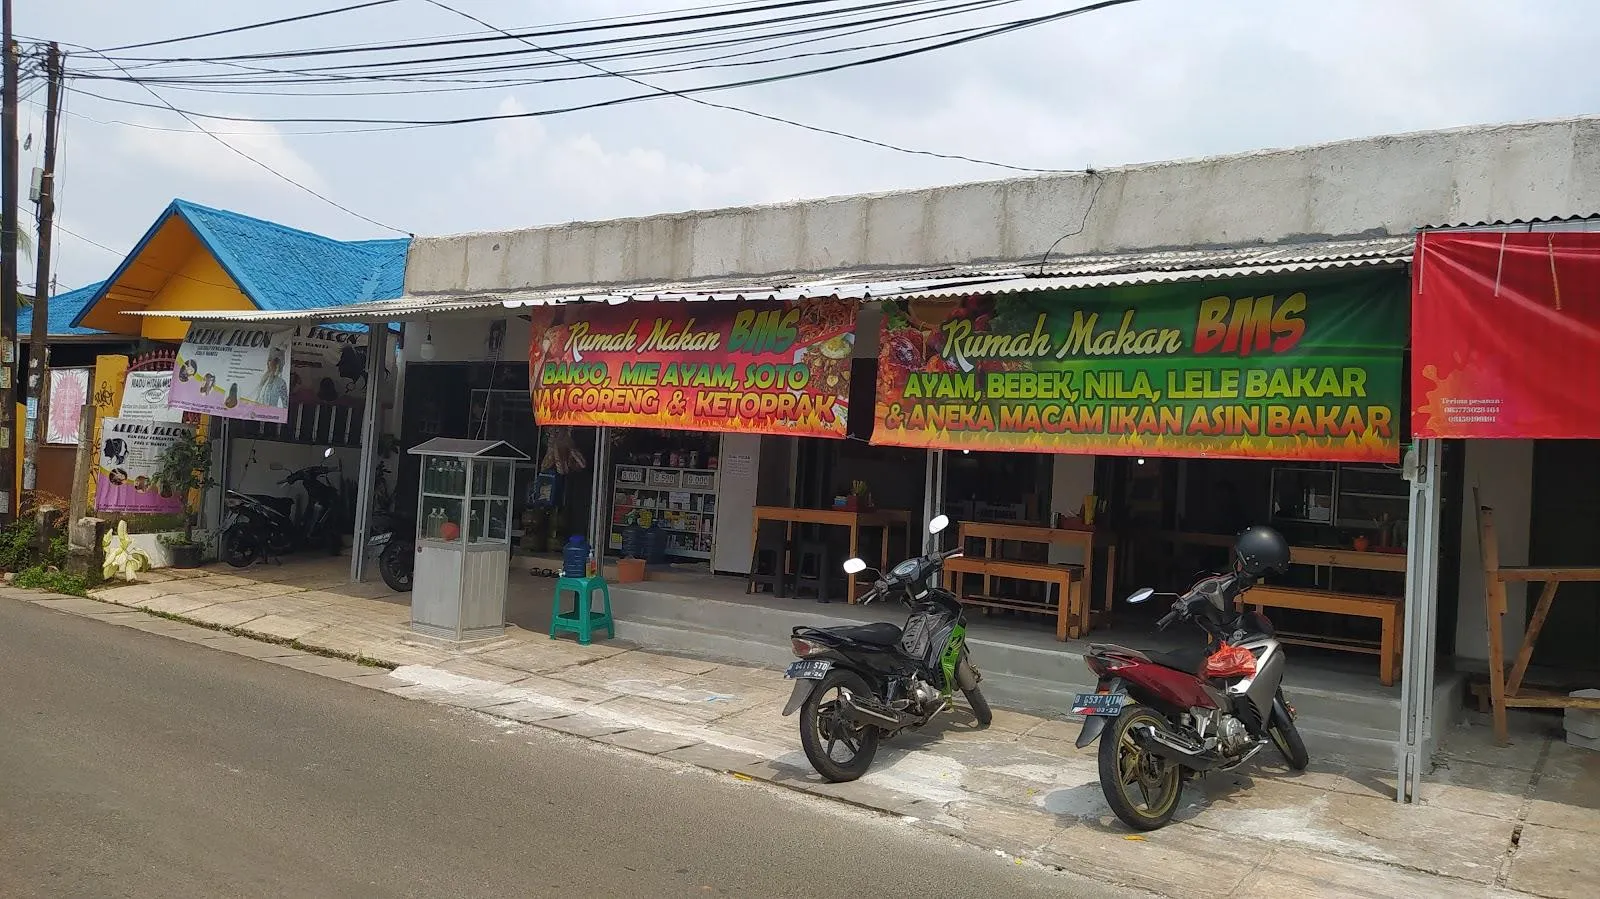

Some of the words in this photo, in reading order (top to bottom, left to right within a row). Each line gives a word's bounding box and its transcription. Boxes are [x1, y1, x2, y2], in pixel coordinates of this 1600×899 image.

[564, 318, 637, 362] Rumah
[638, 317, 720, 353] Makan
[728, 308, 800, 355] BMS
[943, 318, 1052, 374] Rumah
[1055, 310, 1183, 359] Makan
[1196, 294, 1307, 355] BMS
[542, 361, 612, 388] BAKSO,
[619, 363, 658, 386] MIE
[661, 363, 738, 391] AYAM,
[743, 362, 810, 390] SOTO
[903, 370, 982, 403] AYAM,
[986, 369, 1079, 405] BEBEK,
[1084, 369, 1164, 404] NILA,
[1167, 368, 1242, 399] LELE
[1244, 366, 1367, 399] BAKAR
[566, 389, 659, 415] GORENG
[667, 390, 687, 415] &
[694, 390, 837, 421] KETOPRAK
[885, 403, 905, 430] &
[906, 403, 996, 432] ANEKA
[998, 403, 1104, 434] MACAM
[1108, 404, 1184, 434] IKAN
[1186, 405, 1260, 436] ASIN
[1265, 405, 1392, 438] BAKAR
